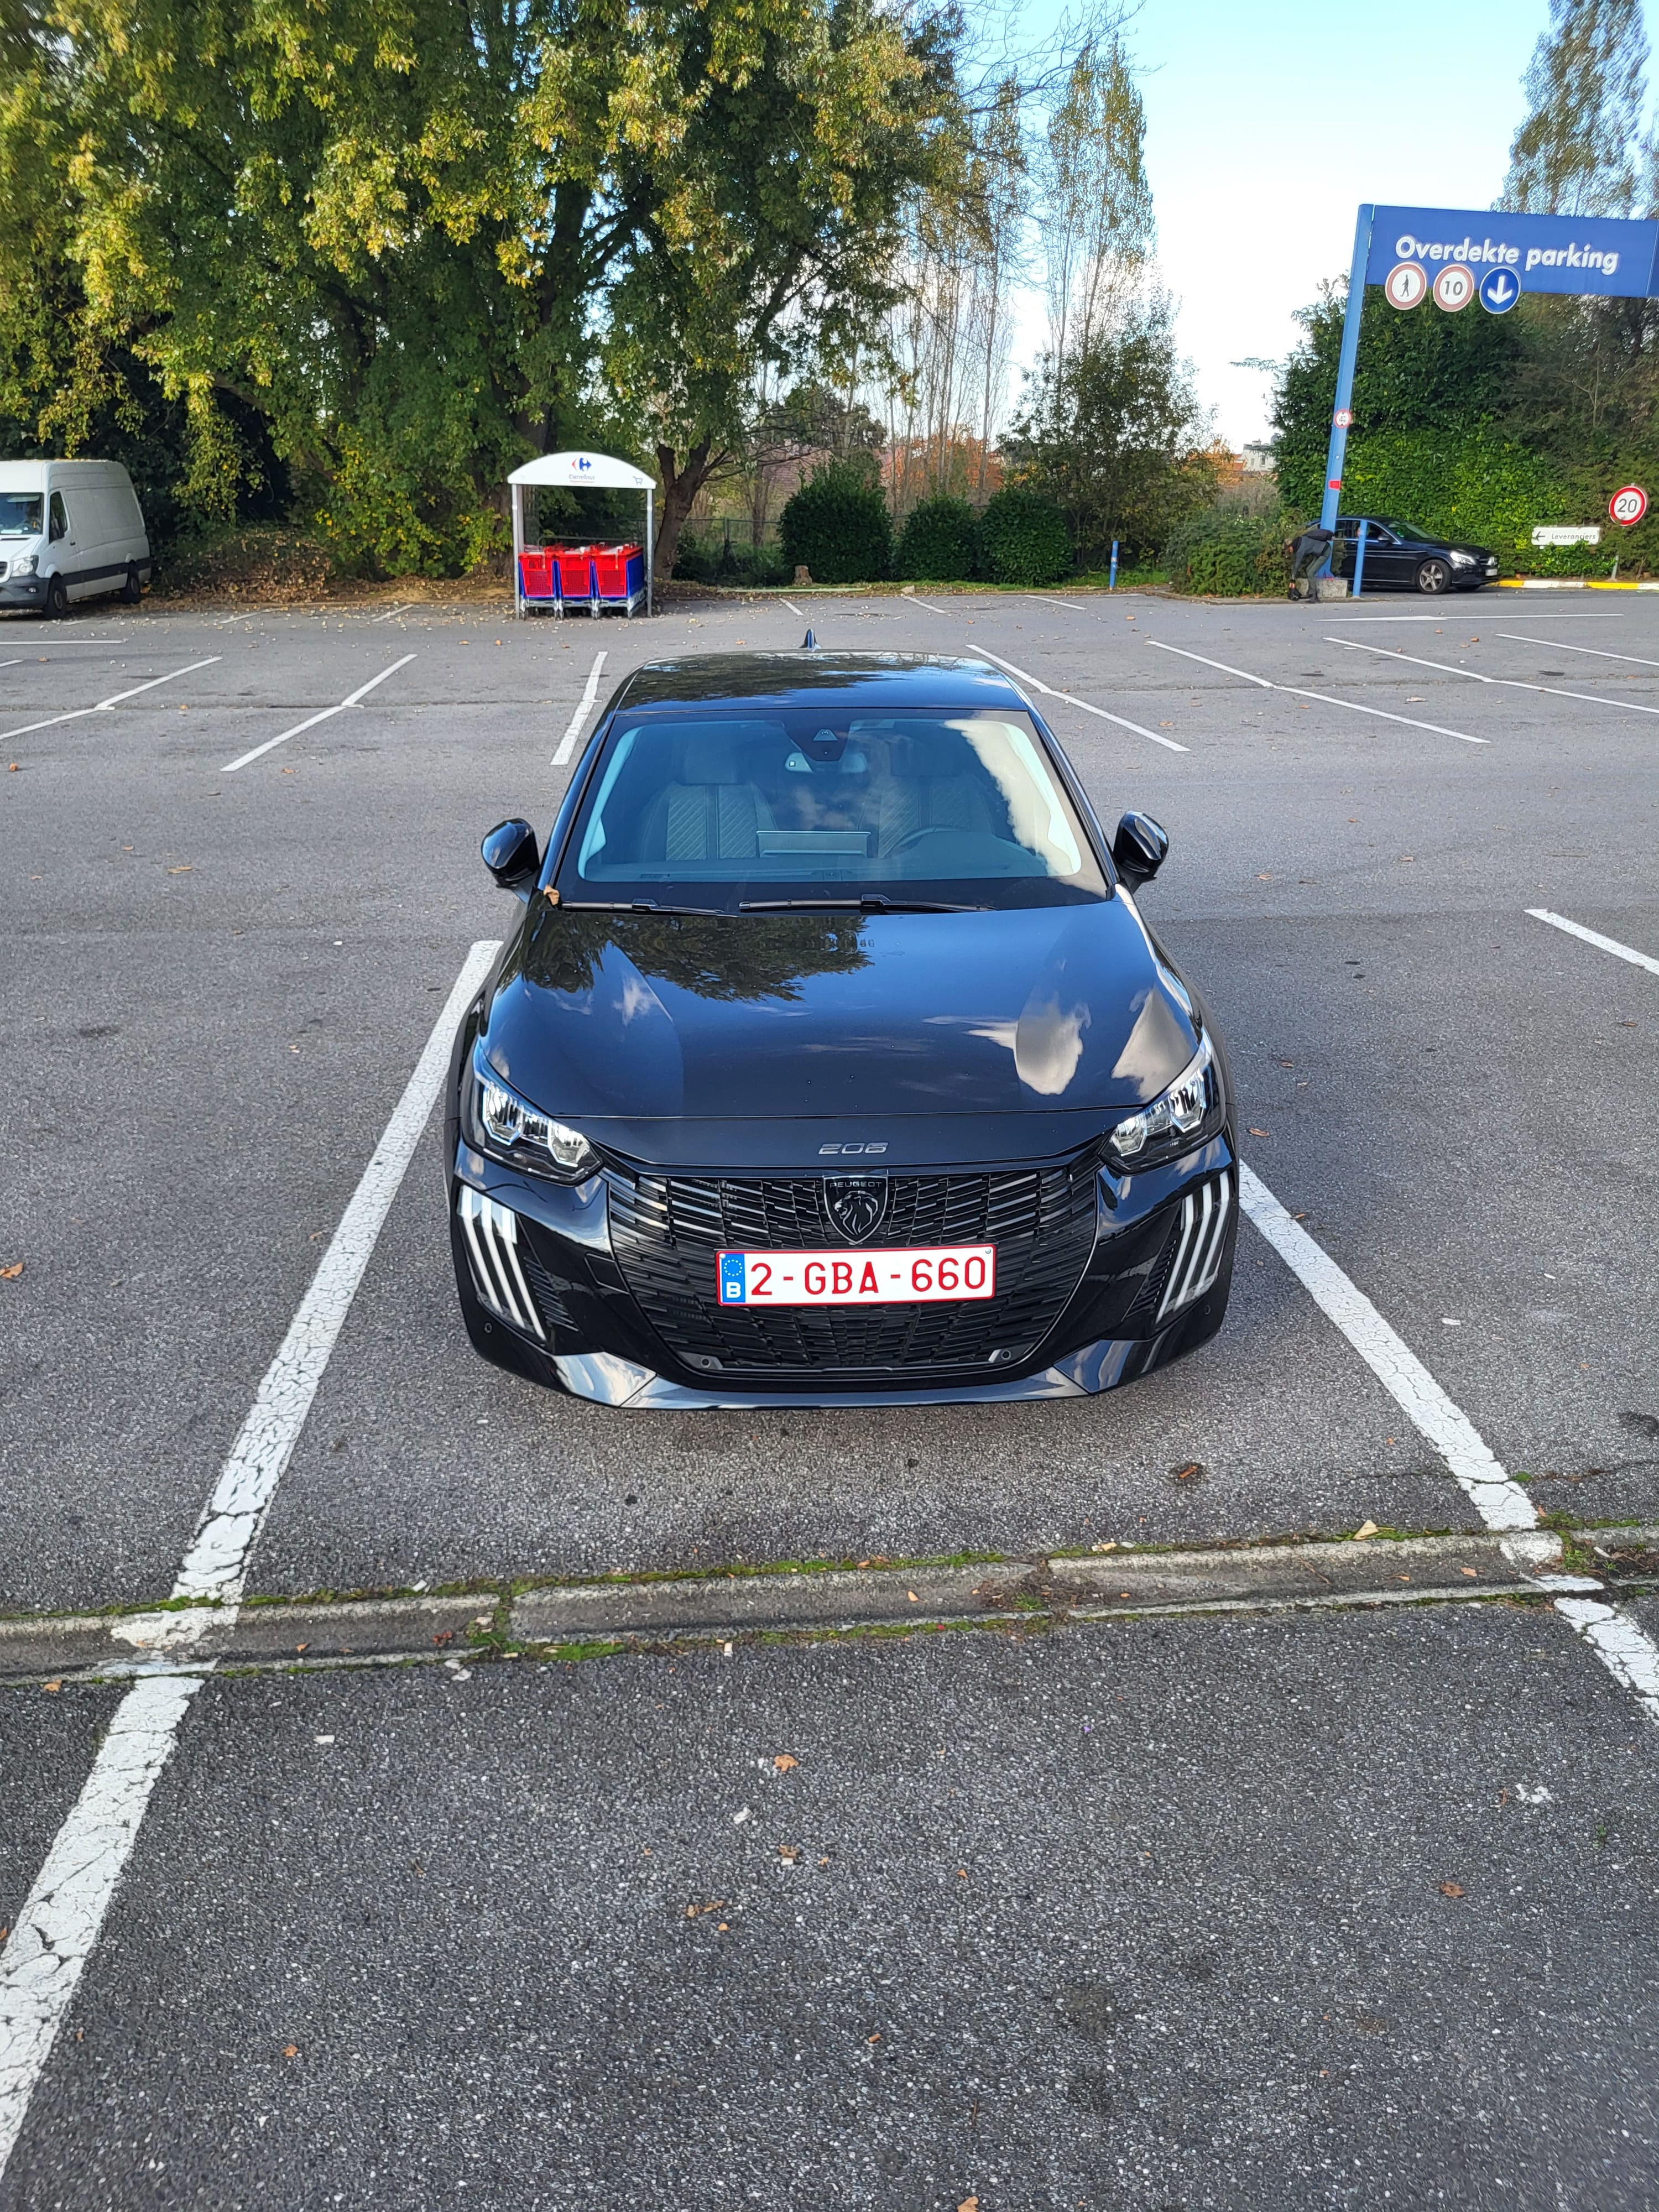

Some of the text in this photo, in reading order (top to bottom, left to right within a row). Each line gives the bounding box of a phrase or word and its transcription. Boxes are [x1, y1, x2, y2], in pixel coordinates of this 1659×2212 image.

[1395, 236, 1620, 275] Overdekte parking
[1445, 275, 1463, 296] 10
[1617, 498, 1637, 513] 20
[818, 1142, 889, 1154] 208
[726, 1282, 741, 1298] B
